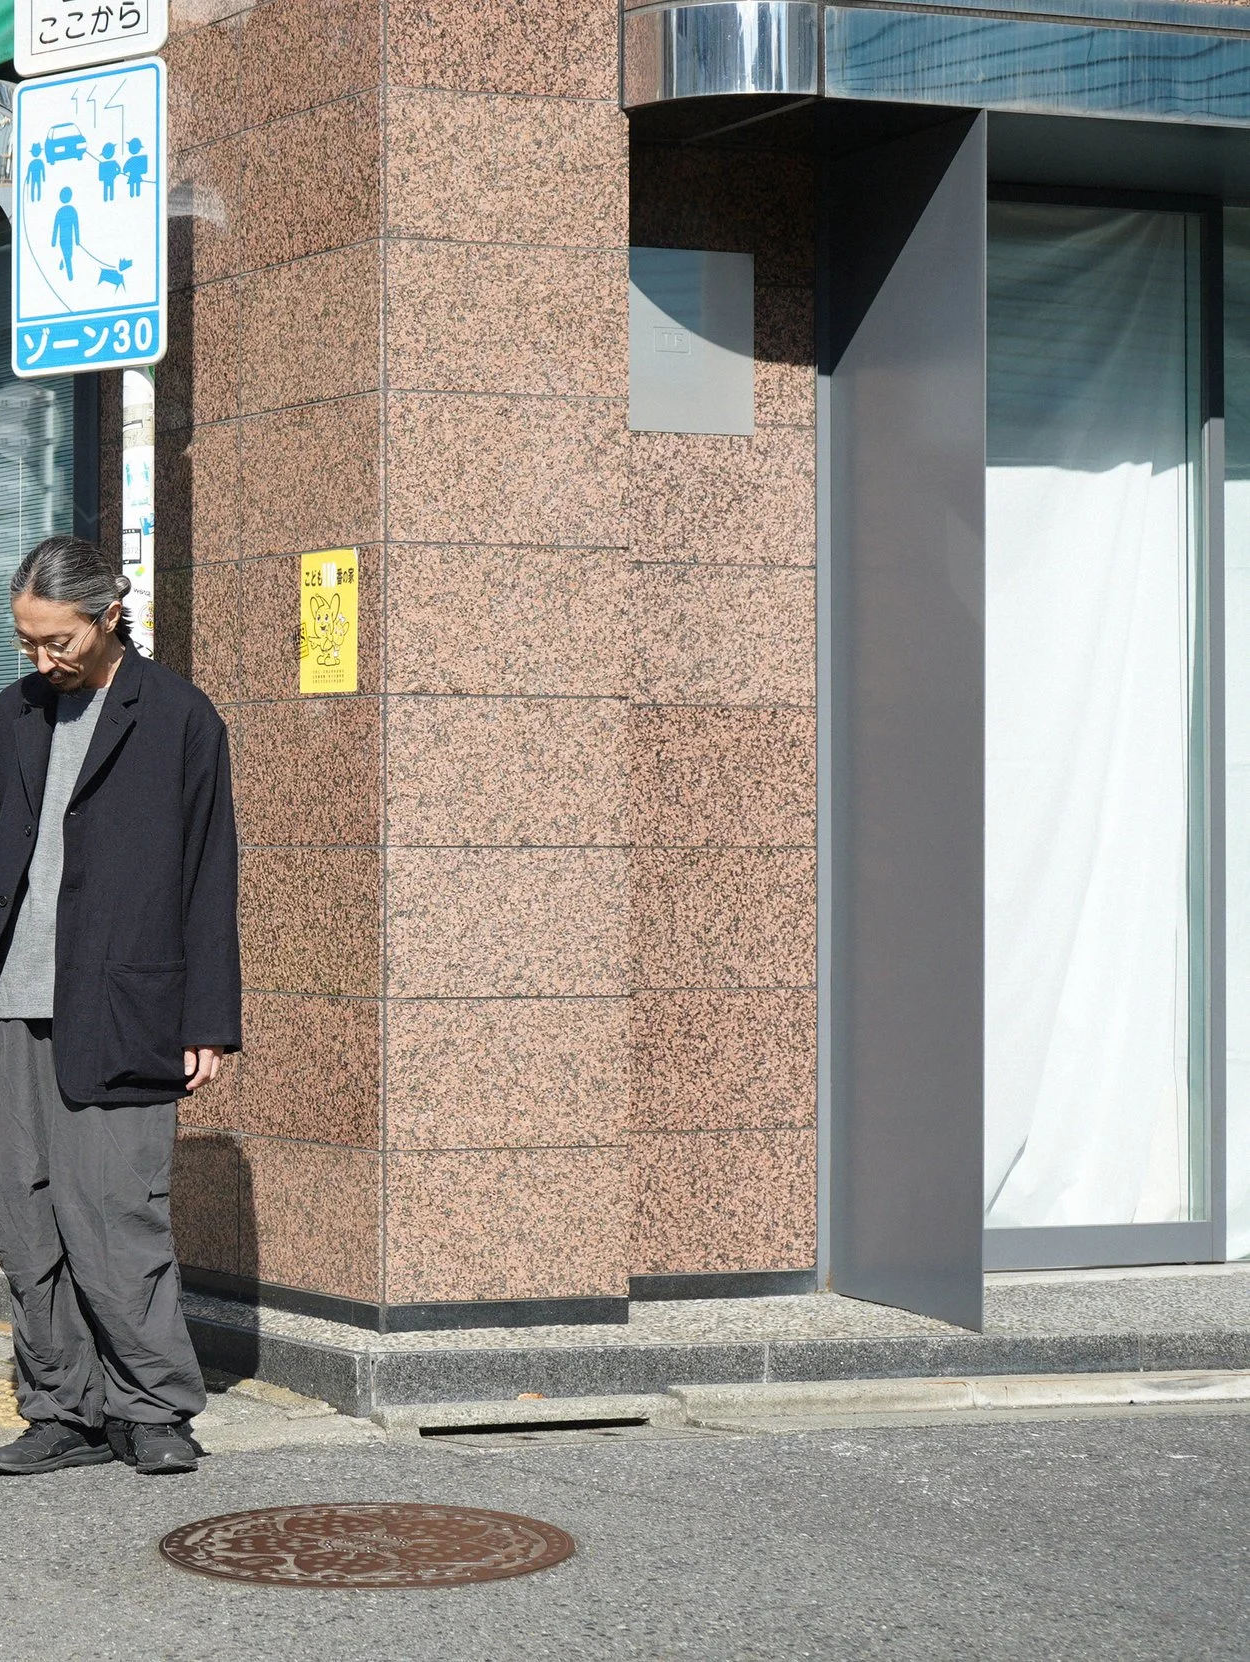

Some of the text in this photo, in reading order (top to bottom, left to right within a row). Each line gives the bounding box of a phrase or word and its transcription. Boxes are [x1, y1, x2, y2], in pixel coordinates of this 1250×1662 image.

[39, 1, 141, 45] ここから
[24, 316, 153, 365] ゾーン30
